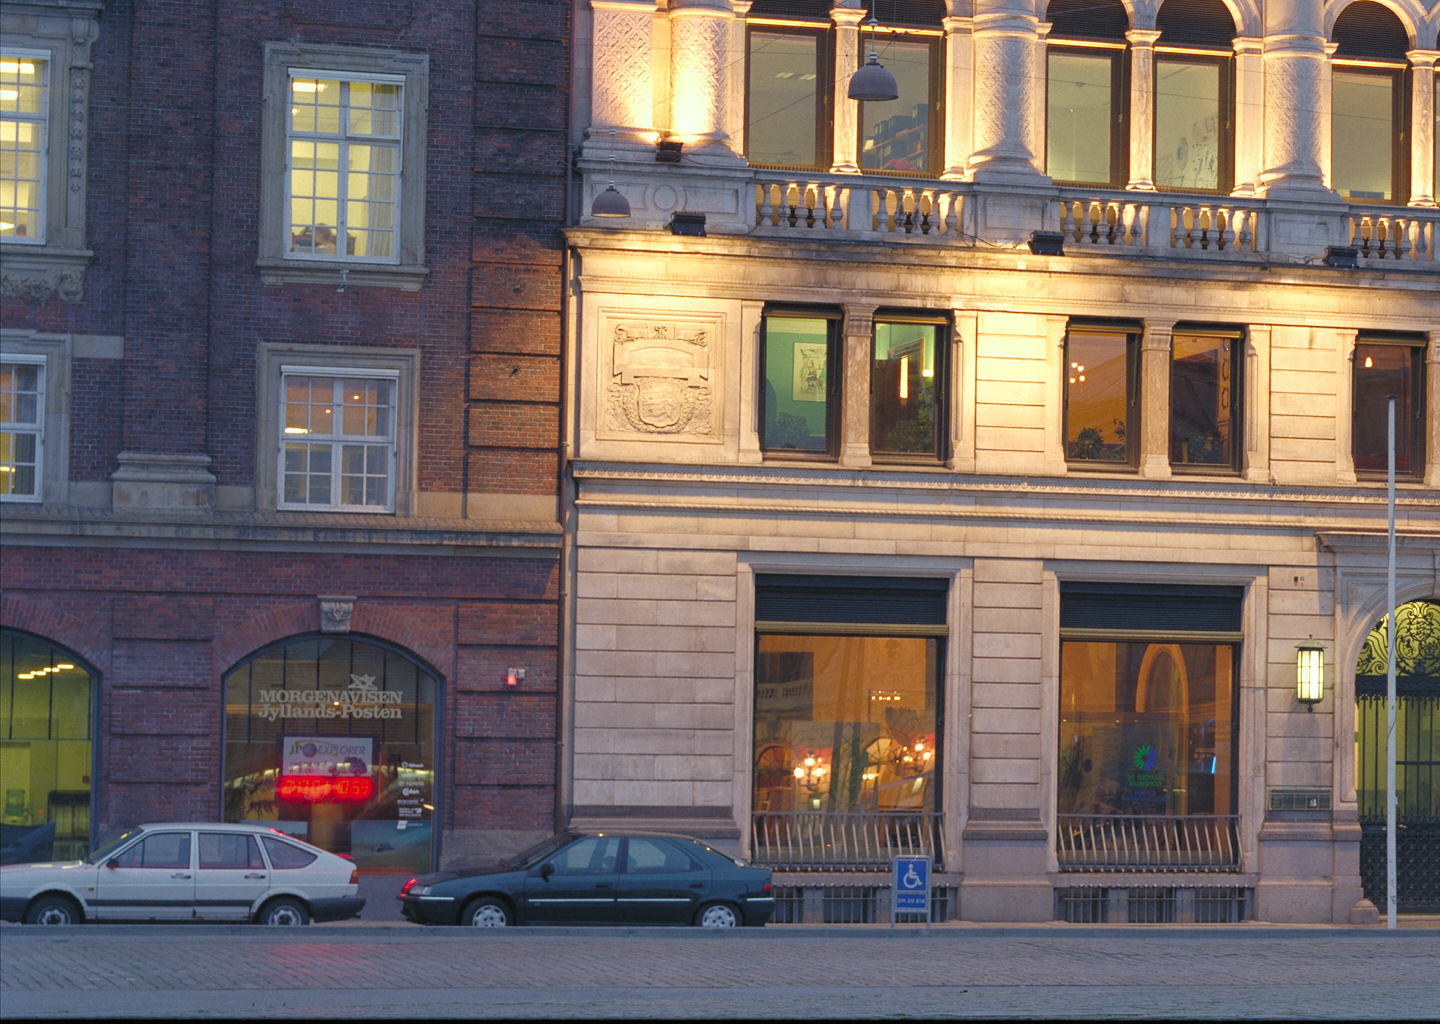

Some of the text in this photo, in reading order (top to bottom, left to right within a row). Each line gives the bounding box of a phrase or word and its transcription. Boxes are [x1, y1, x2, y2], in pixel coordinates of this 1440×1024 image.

[259, 689, 403, 704] MORGENAVISEN
[258, 703, 402, 722] Jyllands-Posten
[317, 745, 366, 755] EXPLORER
